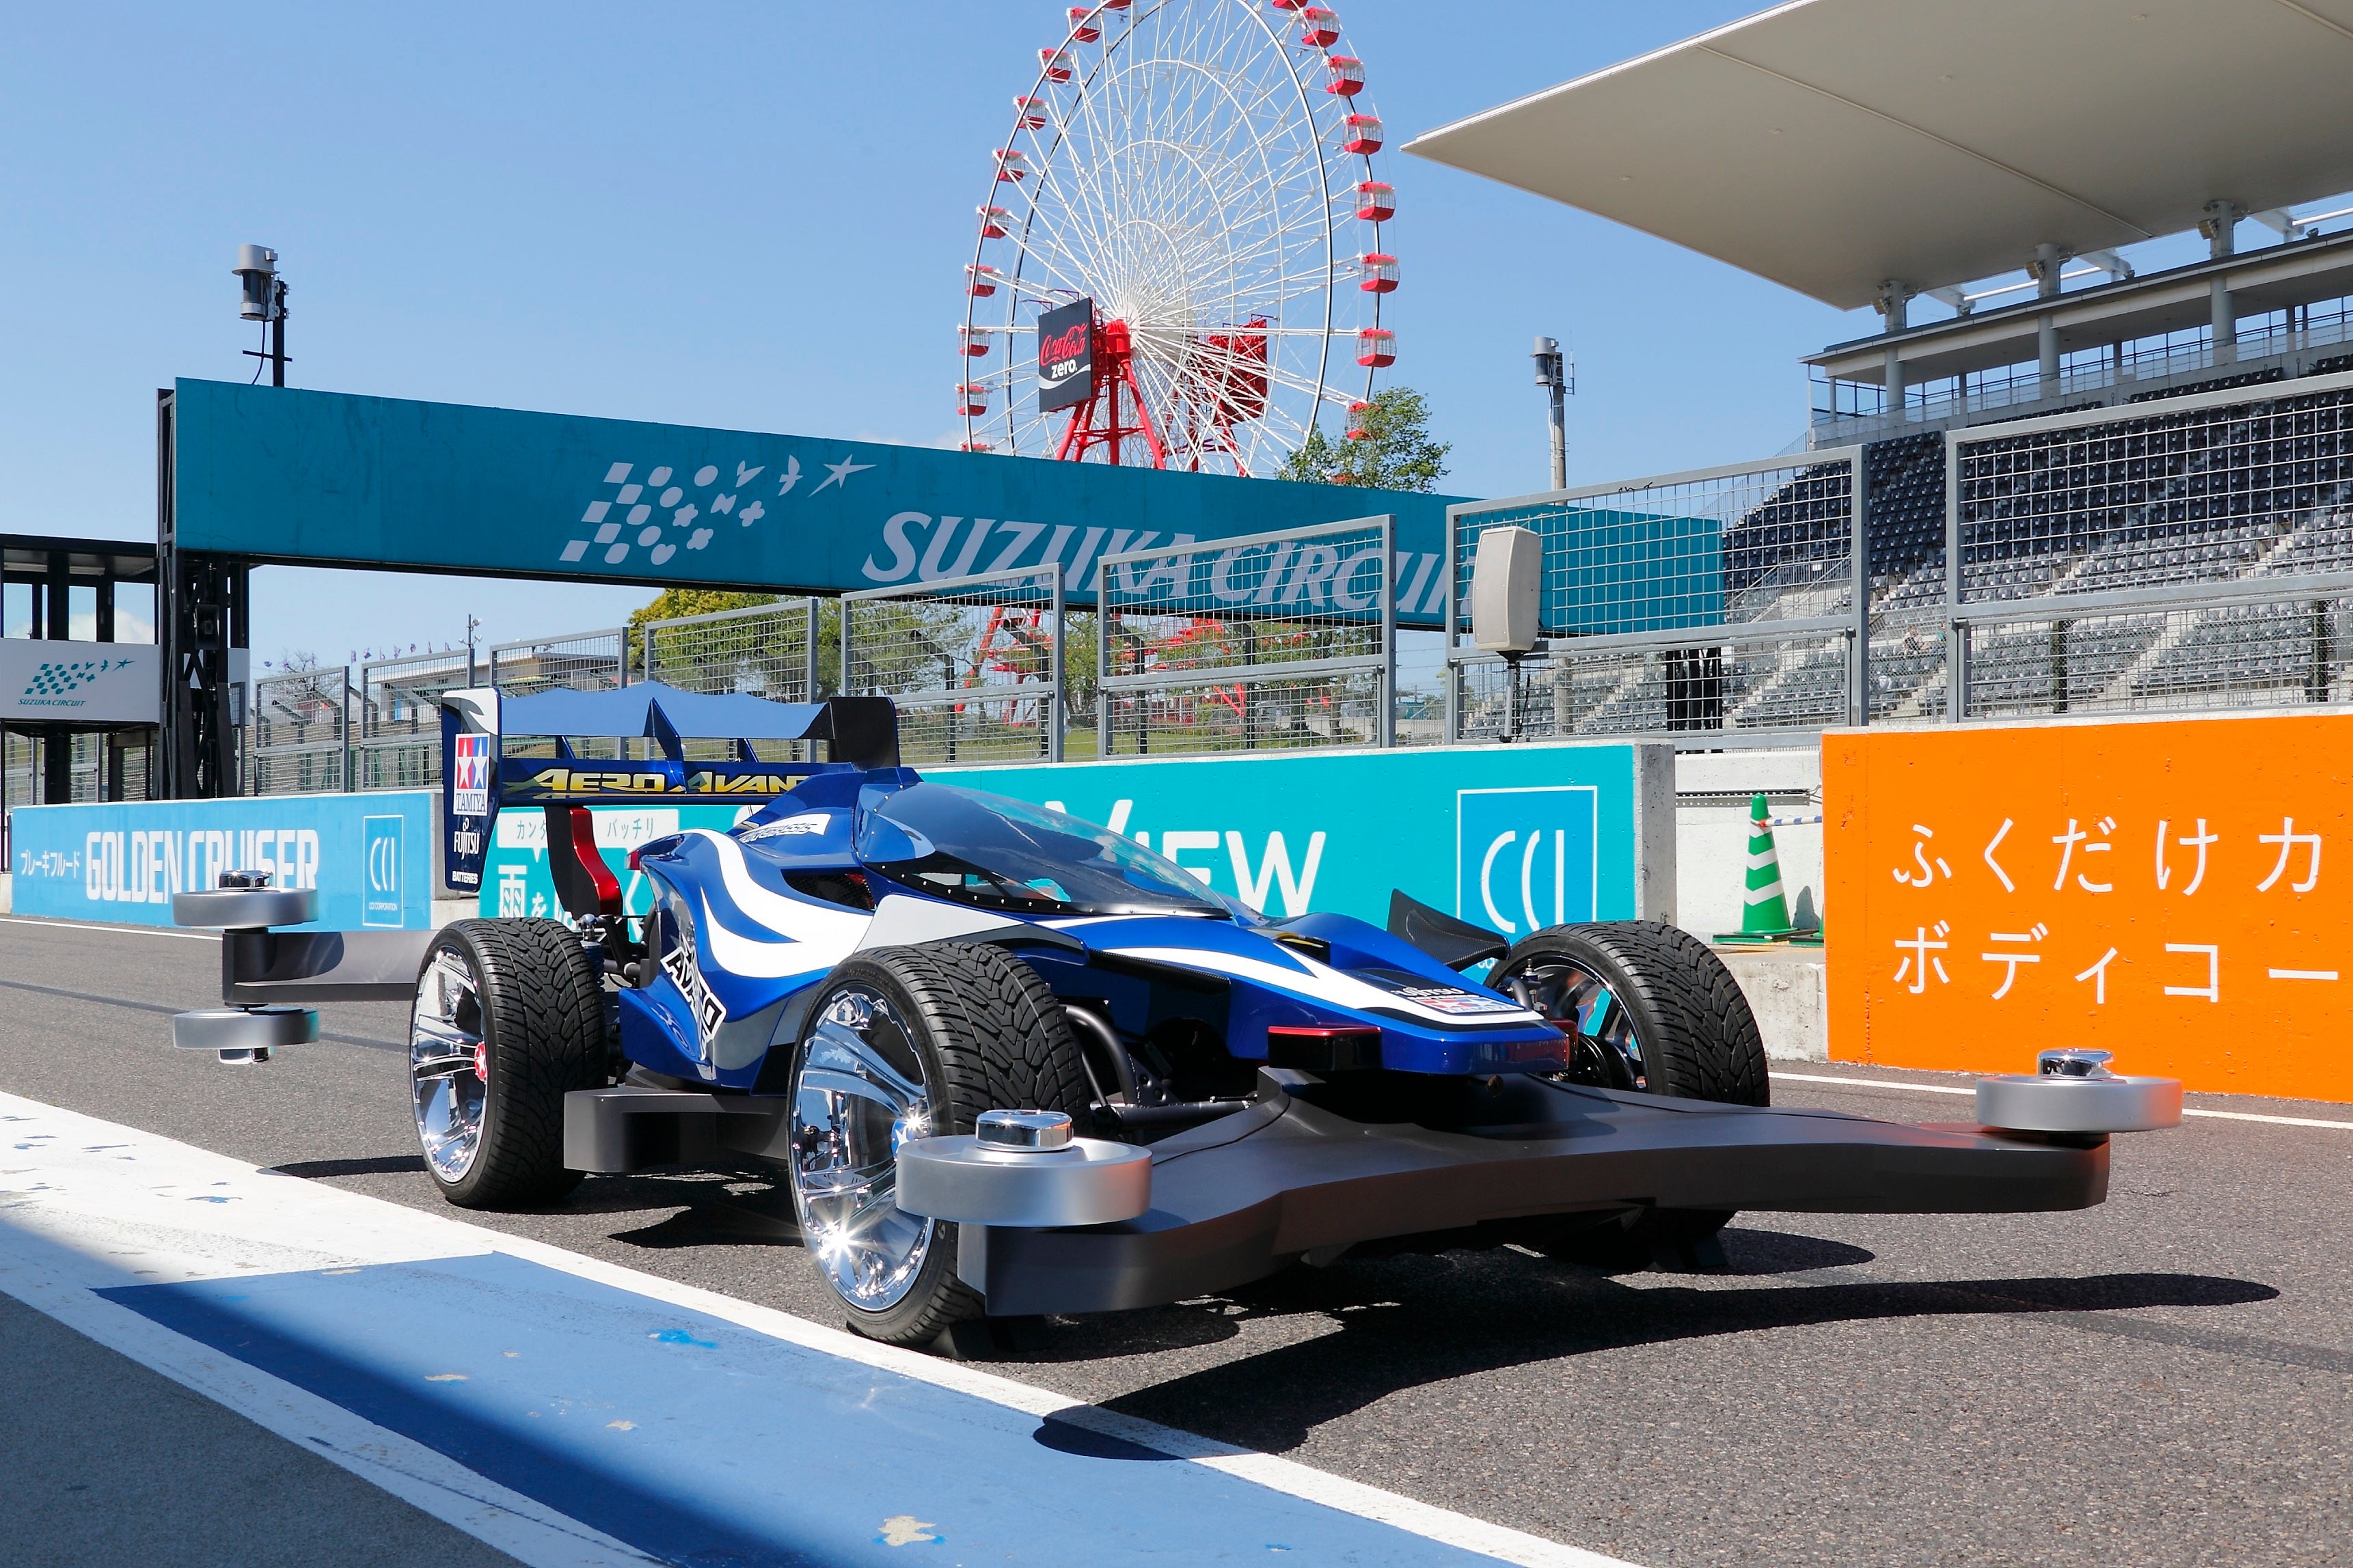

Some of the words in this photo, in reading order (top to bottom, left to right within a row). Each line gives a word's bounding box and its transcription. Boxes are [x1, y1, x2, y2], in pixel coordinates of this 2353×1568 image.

[1040, 322, 1089, 367] Coca-Cola
[861, 511, 1195, 600] SUZUKA
[506, 769, 665, 793] AERO
[670, 771, 810, 793] AVAN
[457, 793, 486, 812] TAMIYA
[453, 825, 480, 859] FUJITSU
[608, 818, 653, 839] バッチリ
[21, 850, 80, 879] ブレーキフルード
[86, 830, 182, 904] GOLDEN
[188, 829, 318, 894] CRUISER
[1892, 816, 2322, 896] ふくだけカ
[452, 871, 478, 885] BATTERIES
[1893, 920, 2339, 1004] ボディコー
